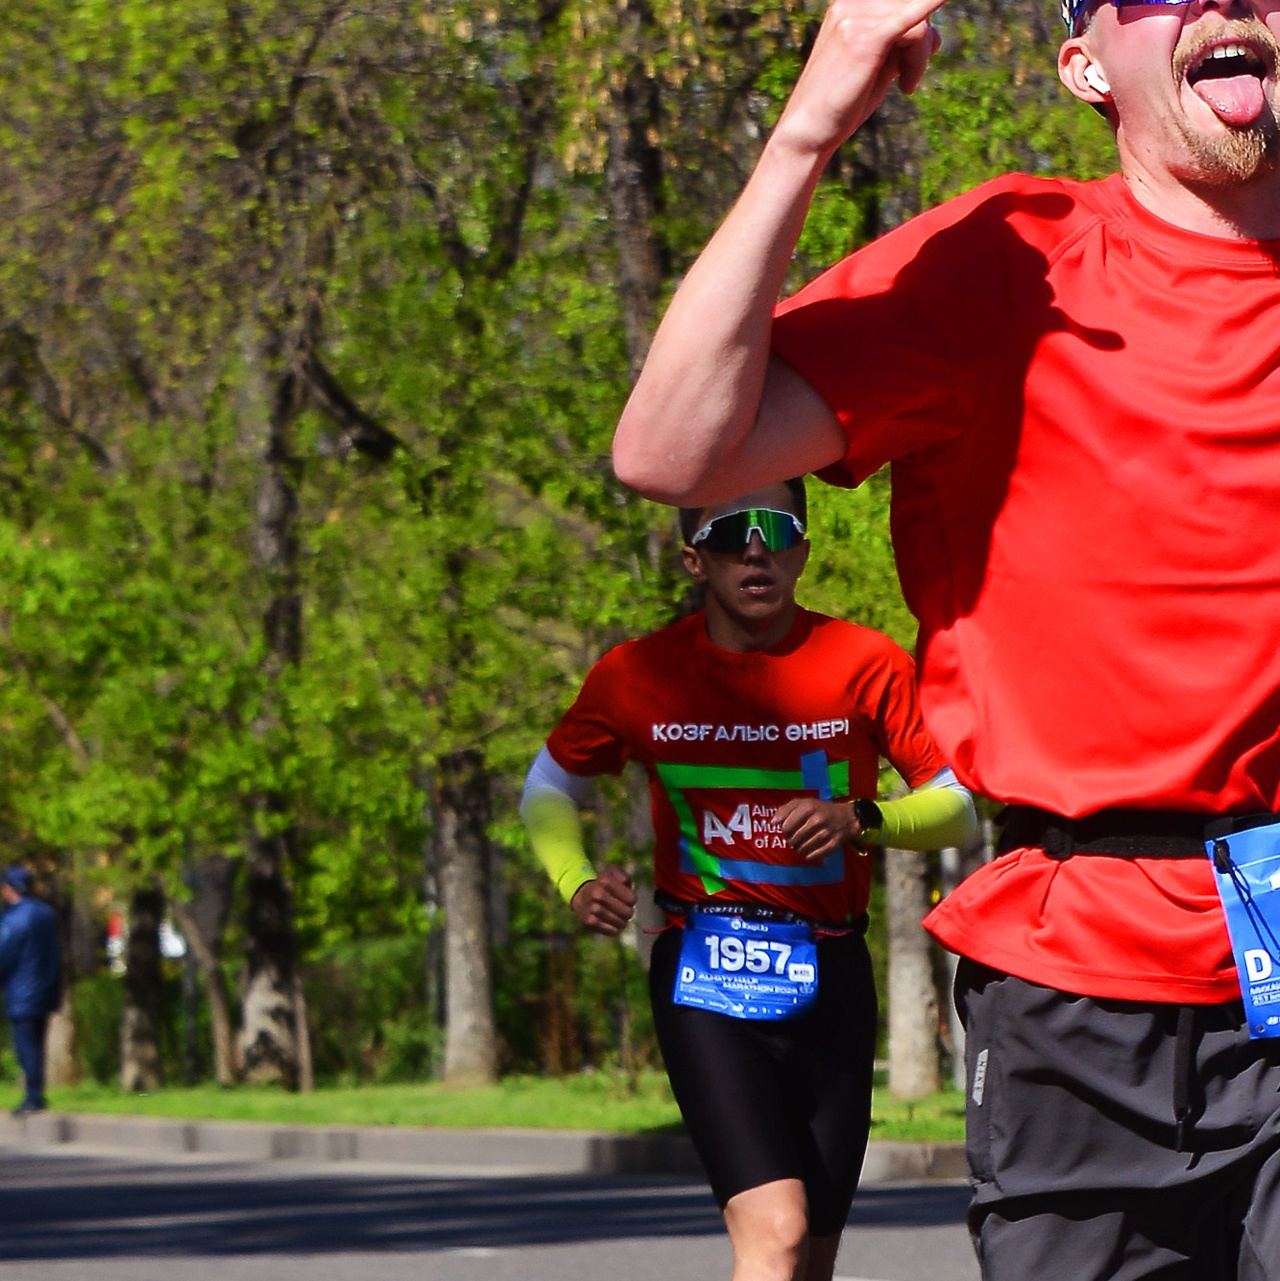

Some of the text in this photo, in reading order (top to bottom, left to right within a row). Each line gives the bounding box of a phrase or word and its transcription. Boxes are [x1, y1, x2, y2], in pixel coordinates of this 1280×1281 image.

[751, 805, 779, 818] Alm
[753, 820, 784, 834] Mus
[754, 835, 794, 849] of Ar
[705, 934, 793, 976] 1957
[1244, 948, 1273, 983] D
[681, 966, 696, 984] D
